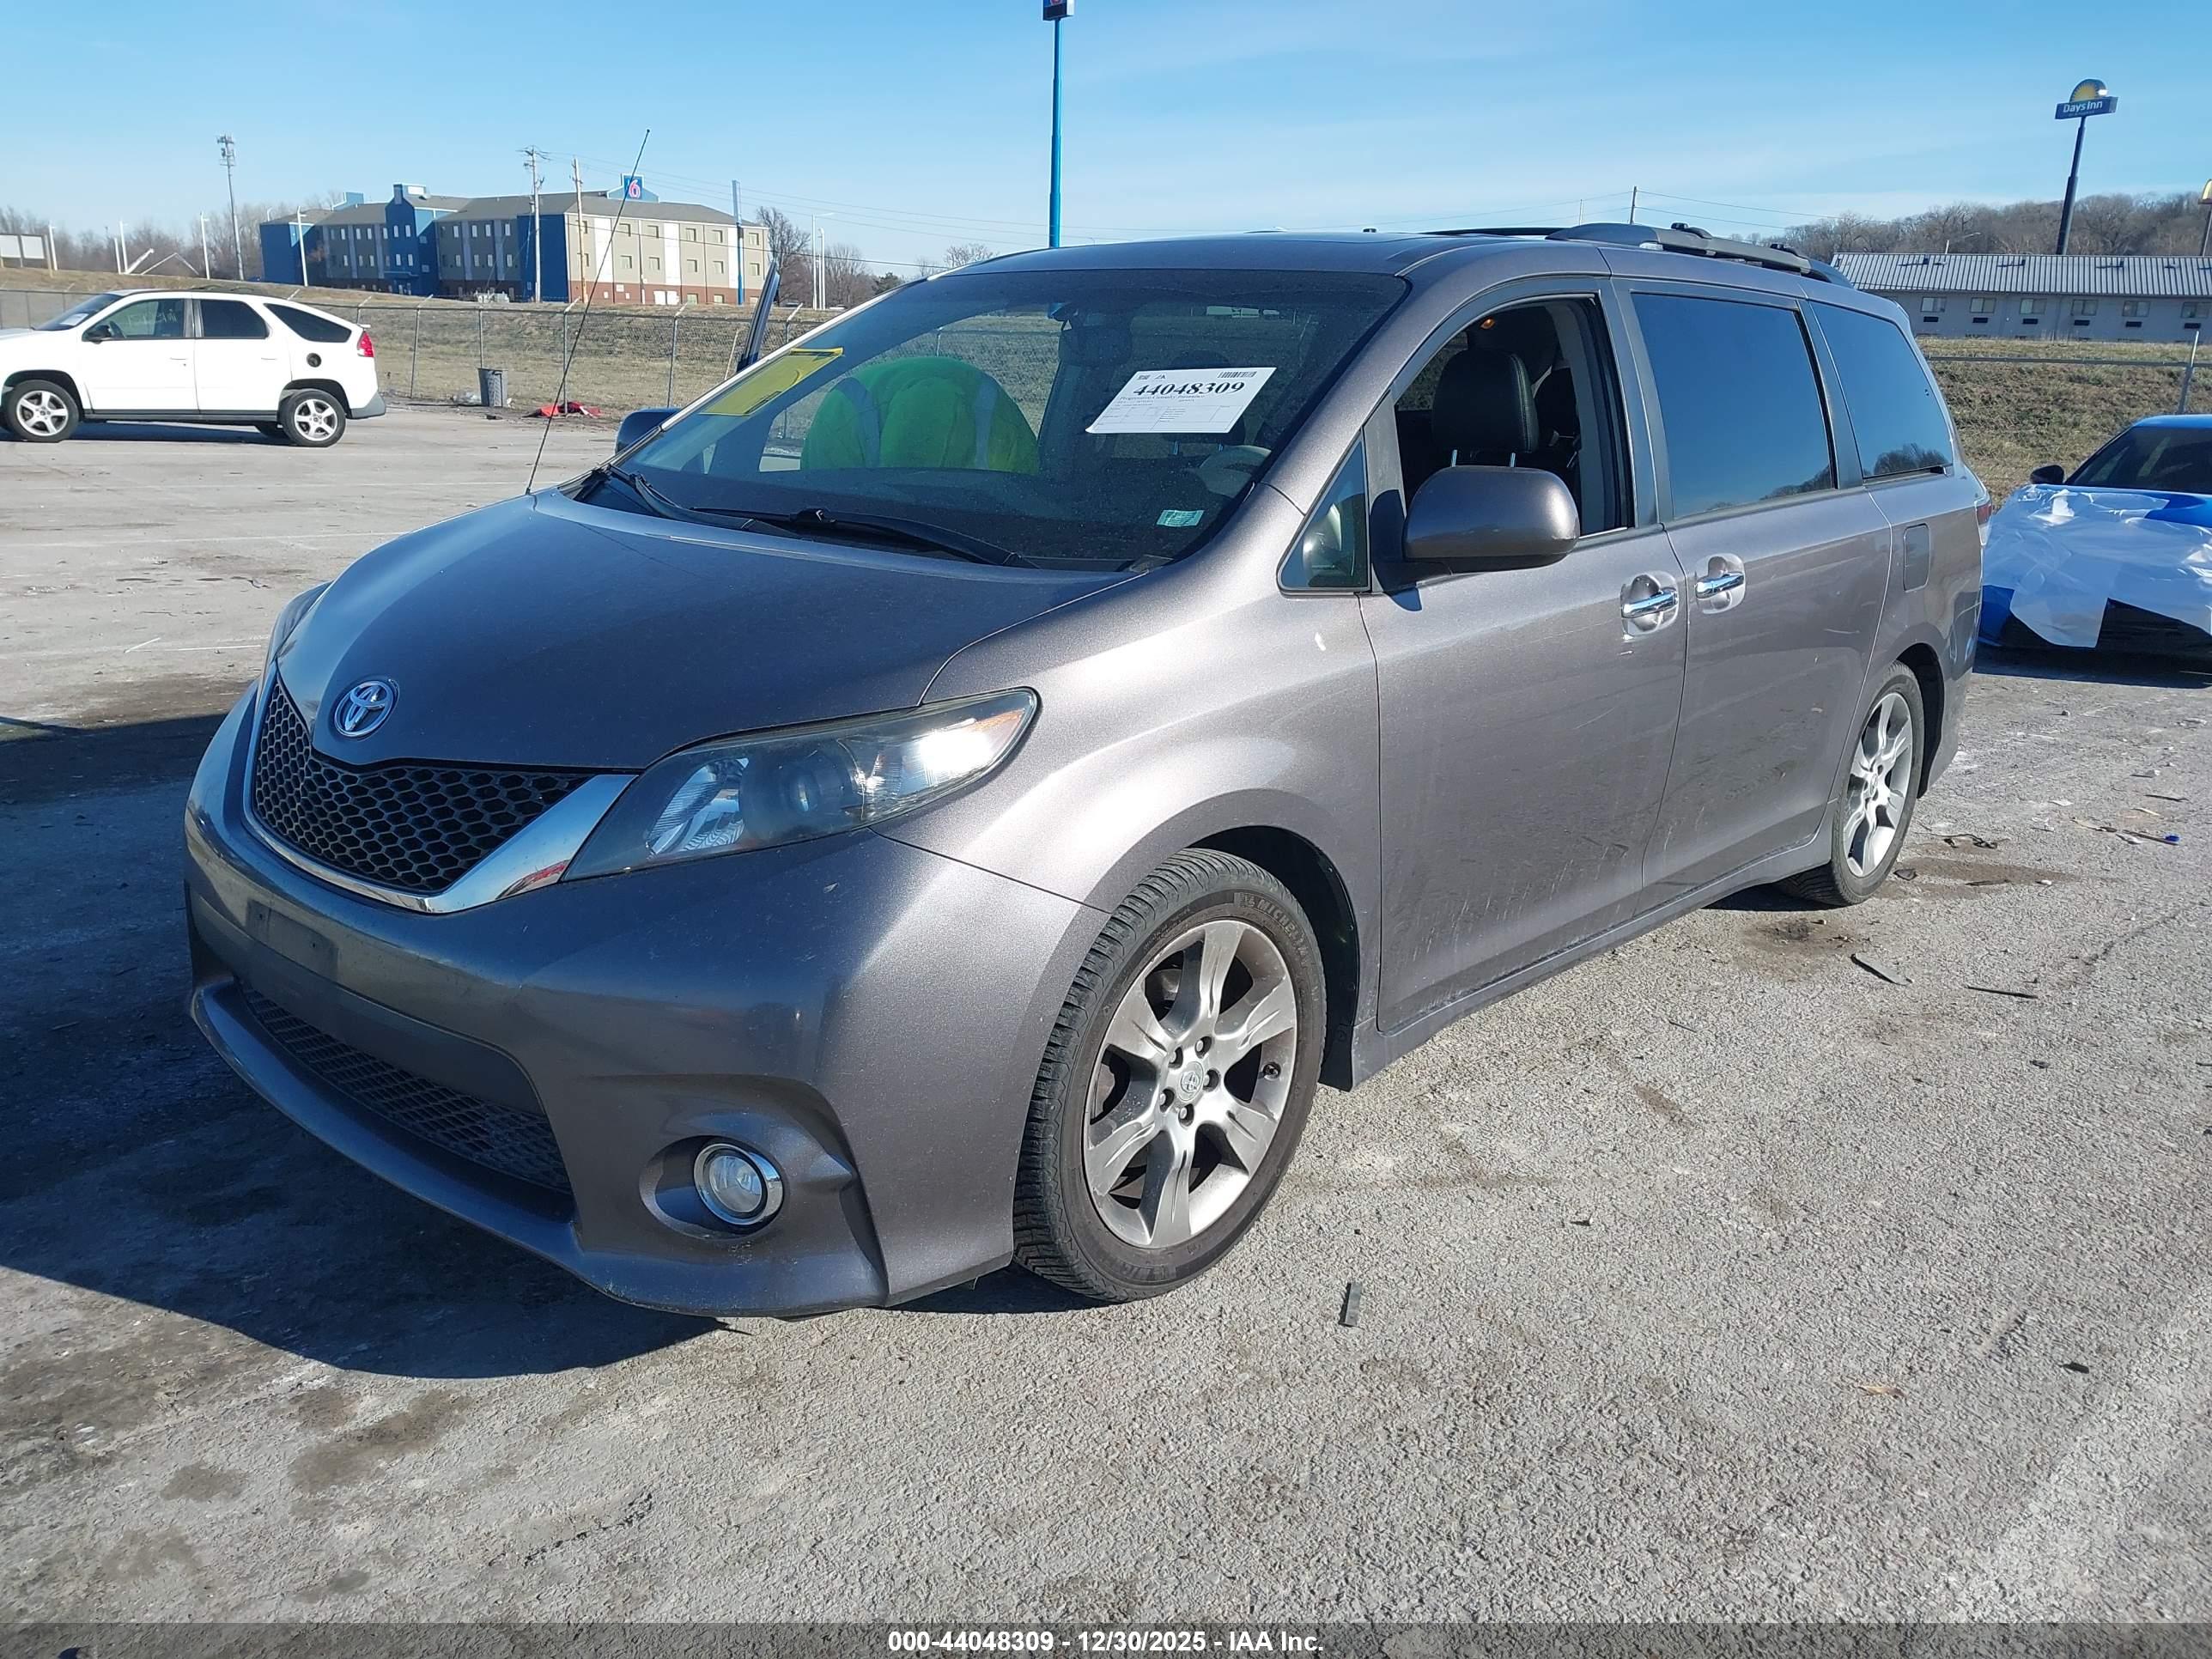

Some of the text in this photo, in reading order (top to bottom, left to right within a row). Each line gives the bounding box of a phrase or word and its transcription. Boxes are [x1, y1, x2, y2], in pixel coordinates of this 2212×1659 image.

[2063, 100, 2103, 112] Days Inn
[629, 179, 641, 198] 6
[1133, 381, 1245, 396] 44048309
